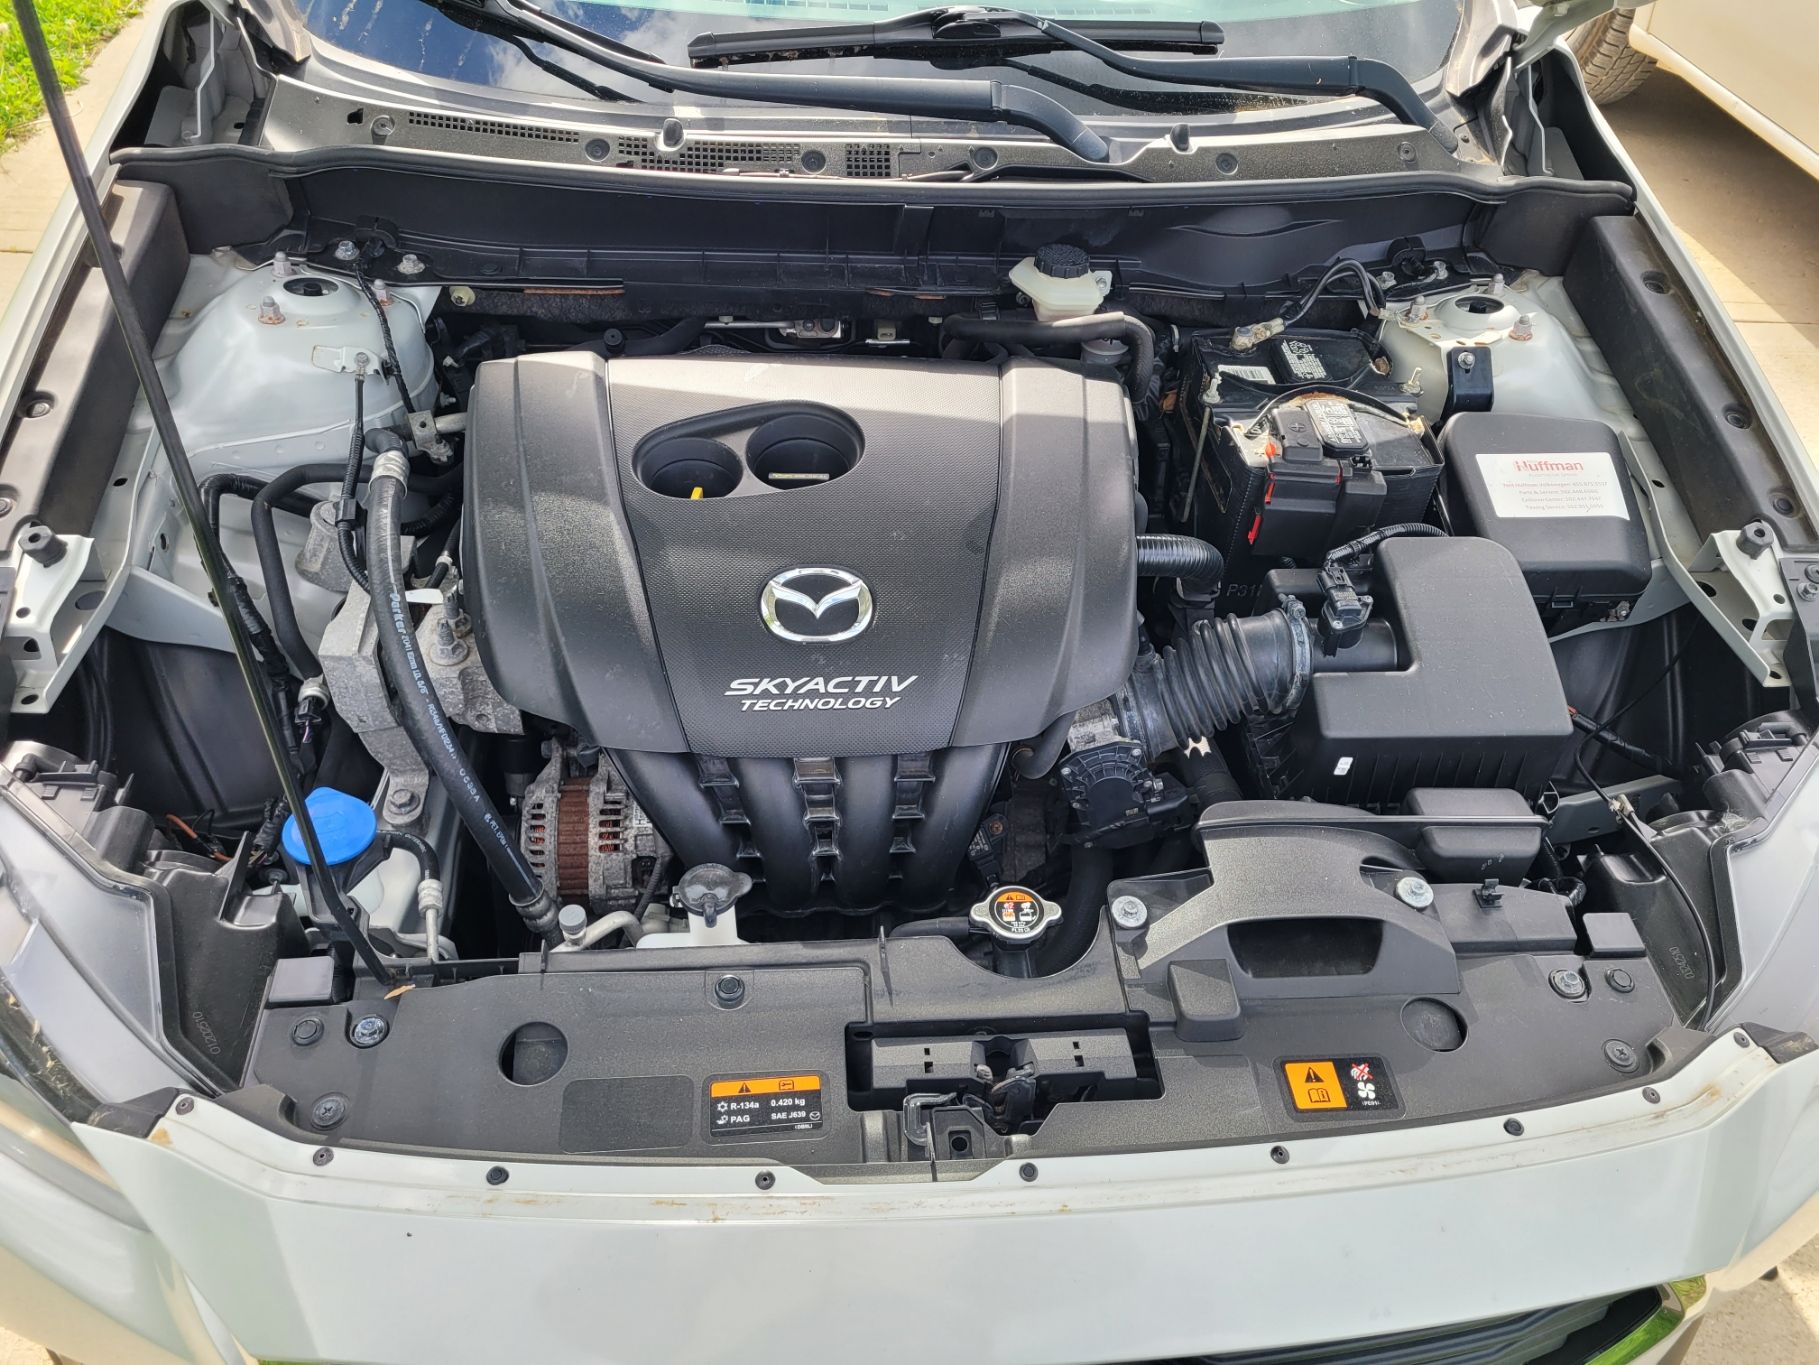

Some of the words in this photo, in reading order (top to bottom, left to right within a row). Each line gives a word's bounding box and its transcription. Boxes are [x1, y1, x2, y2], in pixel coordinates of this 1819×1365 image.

[389, 592, 407, 634] Parker
[724, 675, 918, 696] SKYACTIV
[740, 697, 901, 711] TECHNOLOGY
[730, 1101, 759, 1110] R-134a
[770, 1098, 793, 1107] 0.420
[794, 1097, 805, 1106] kg
[730, 1114, 750, 1123] PAG
[771, 1112, 787, 1120] SAE
[788, 1110, 806, 1119] J639
